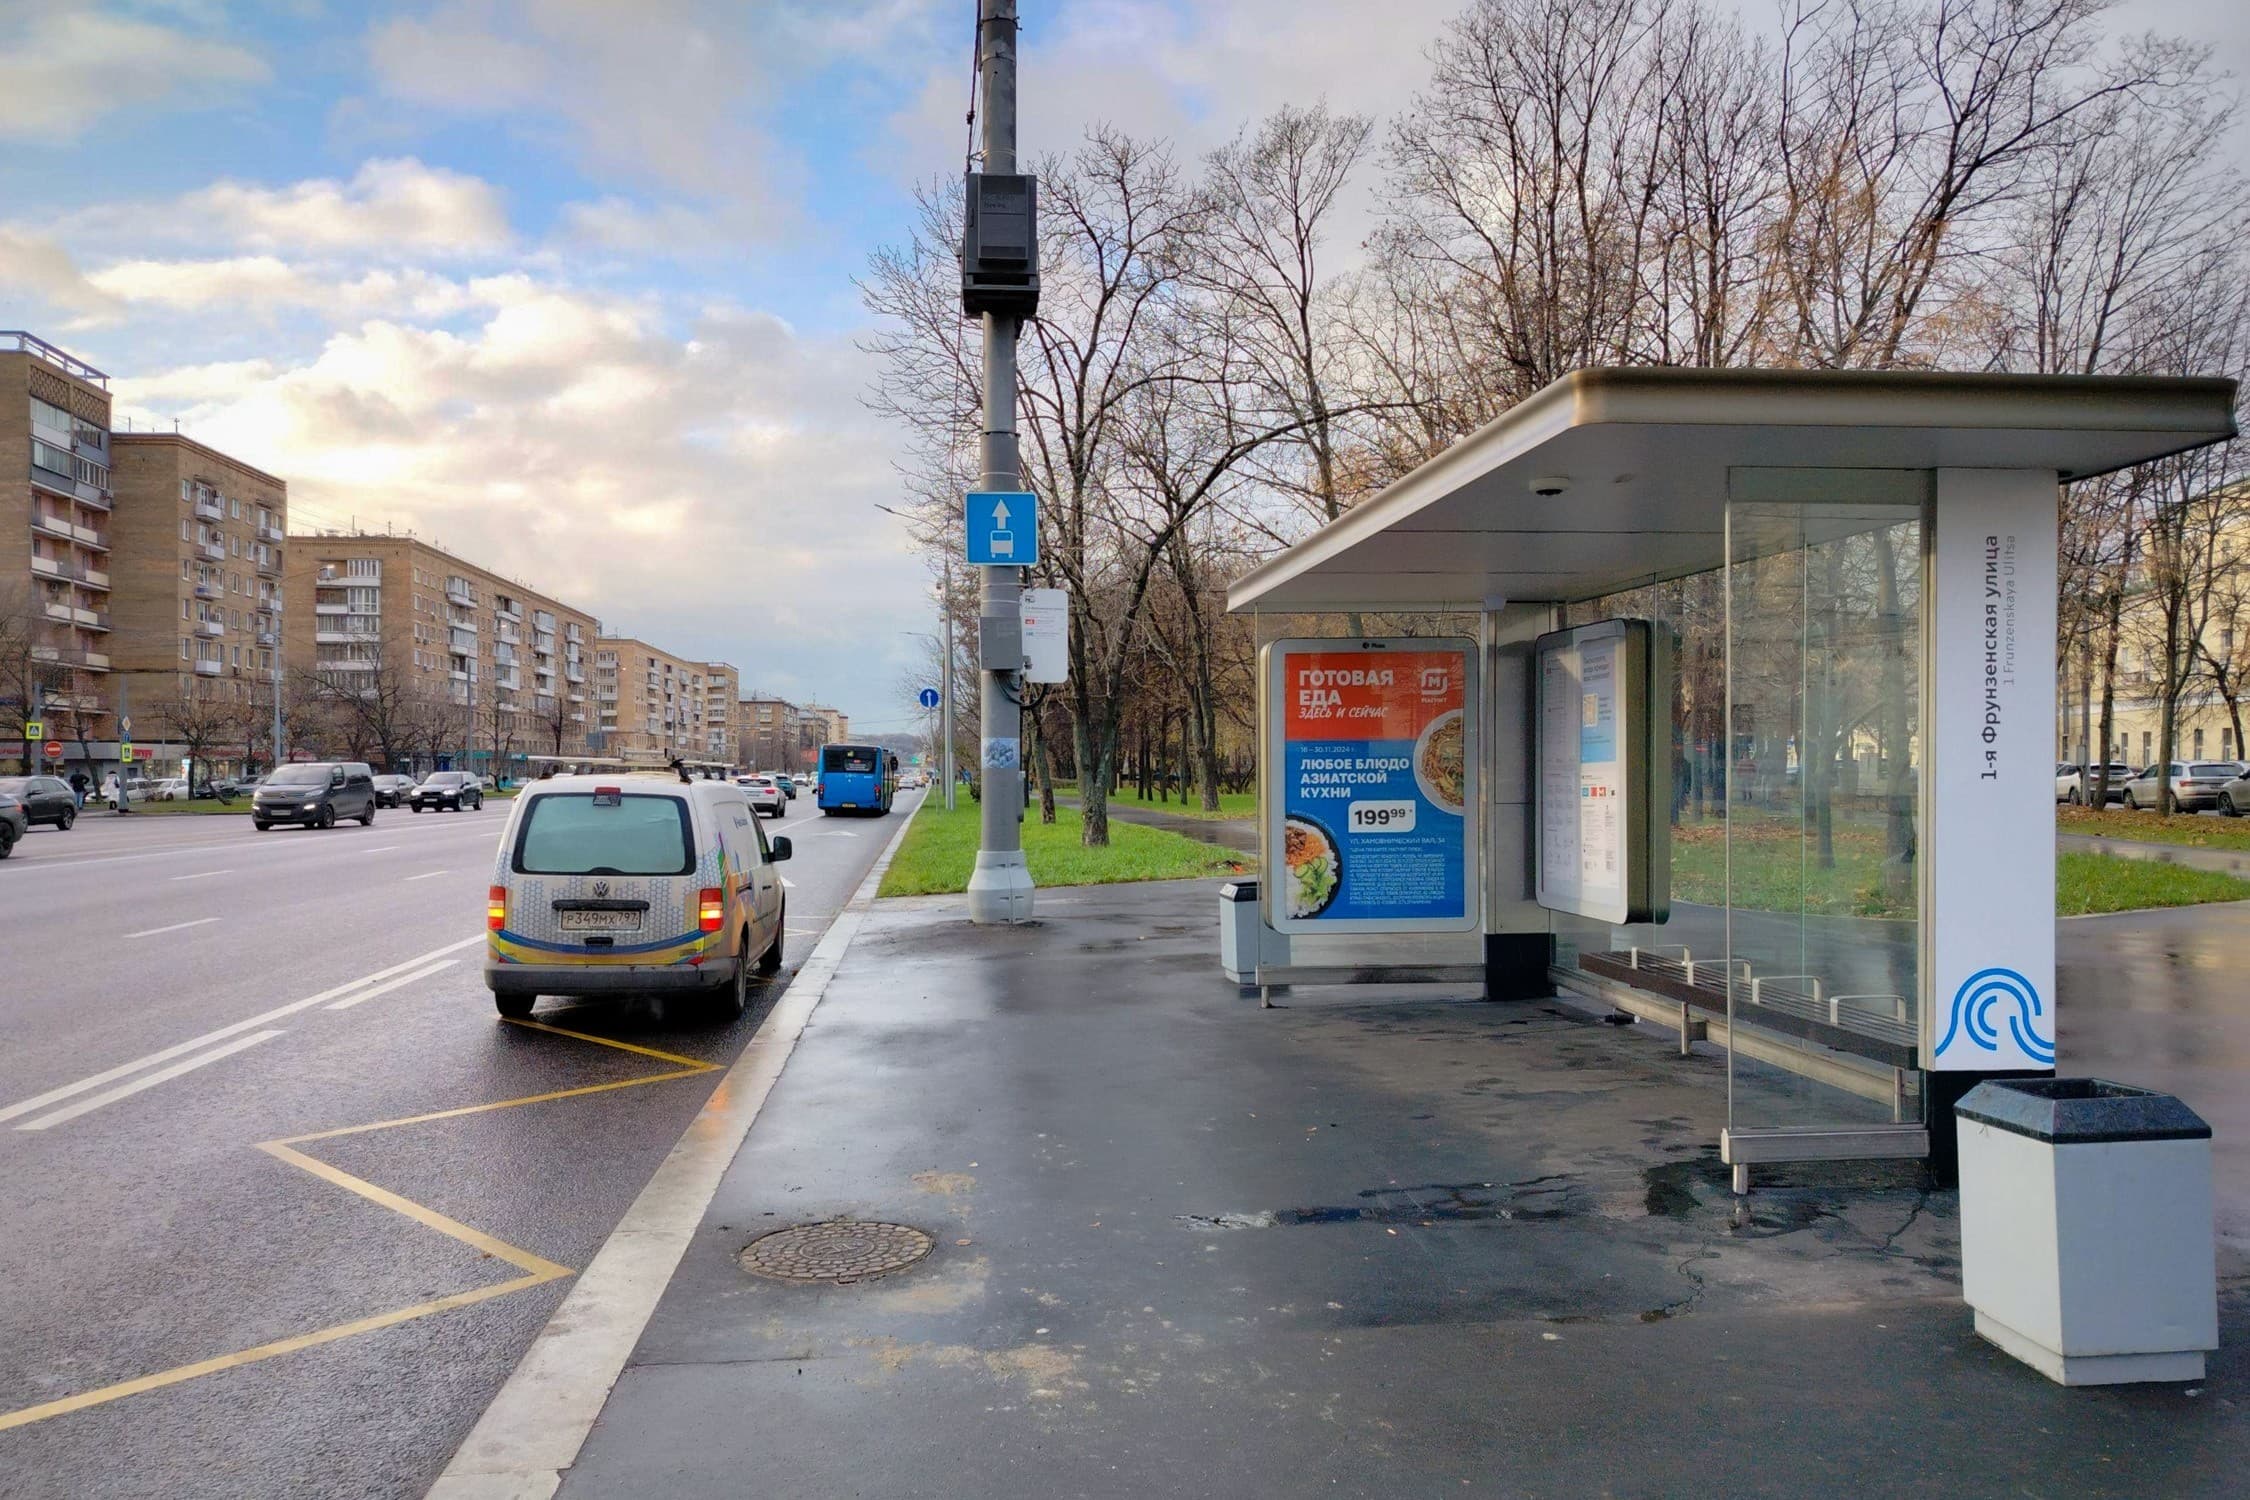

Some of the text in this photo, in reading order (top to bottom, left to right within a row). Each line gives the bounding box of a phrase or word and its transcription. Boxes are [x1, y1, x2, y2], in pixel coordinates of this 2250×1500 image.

[2003, 535, 2015, 576] Ulitsa
[2003, 580, 2017, 673] Frunzenskaya
[1981, 535, 2000, 781] 1-я Фрунзенская улица
[1299, 670, 1394, 687] ГОТОВАЯ
[1299, 690, 1342, 708] ЕДА
[1298, 704, 1389, 719] ЗДЕСЬ И СЕЙЧАС
[1300, 758, 1409, 771] ЛЮБОЕ БЛЮДО
[1300, 770, 1387, 784] АЗИАТСКОЙ
[1300, 787, 1351, 798] КУХНИ
